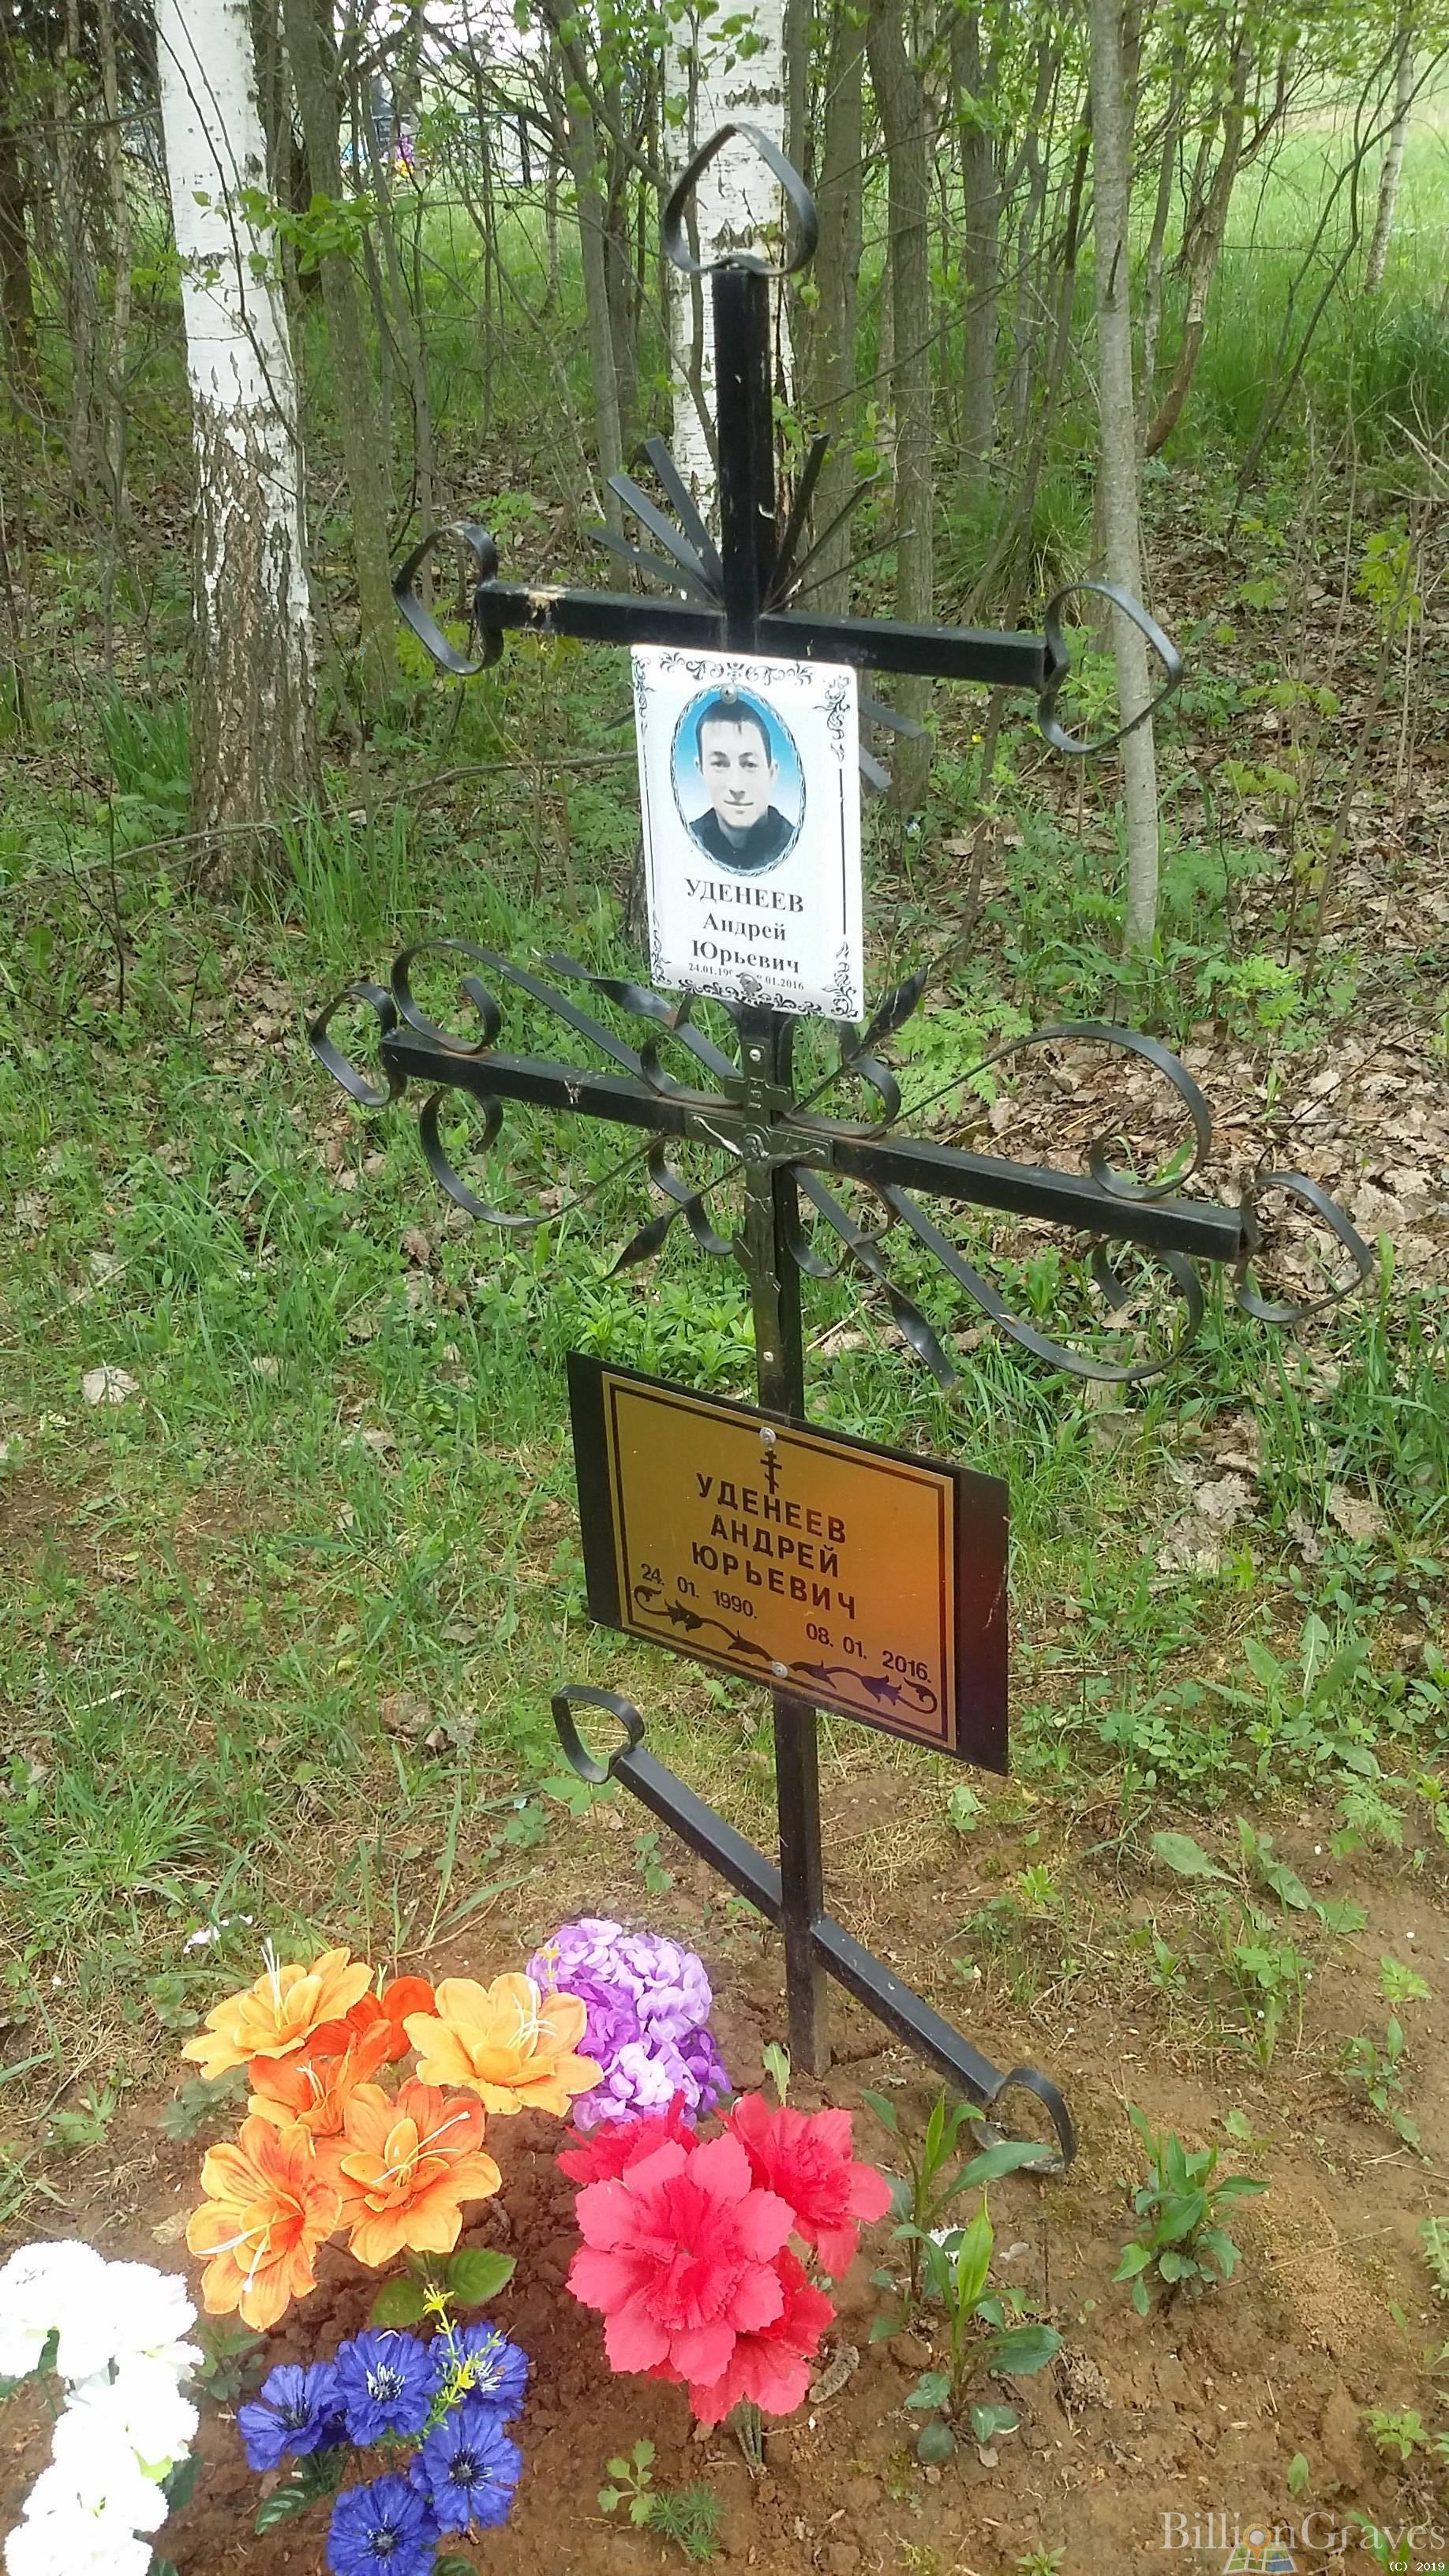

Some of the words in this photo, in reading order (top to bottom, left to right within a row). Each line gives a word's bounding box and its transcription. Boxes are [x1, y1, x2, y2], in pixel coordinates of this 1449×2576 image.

[684, 878, 803, 912] УДЕНЕЕВ
[702, 912, 787, 941] Андрей
[691, 940, 799, 974] Юрьевич
[696, 1473, 846, 1543] УДЕНЕЕВ
[711, 1514, 838, 1578] АНДРЕЙ
[692, 1541, 855, 1619] ЮРЬЕВИЧ
[641, 1563, 665, 1586] 24.
[677, 1576, 699, 1598] 01.
[713, 1589, 758, 1619] 1990.
[806, 1623, 833, 1647] 08.
[843, 1637, 867, 1659] 01.
[882, 1650, 931, 1683] 2016.
